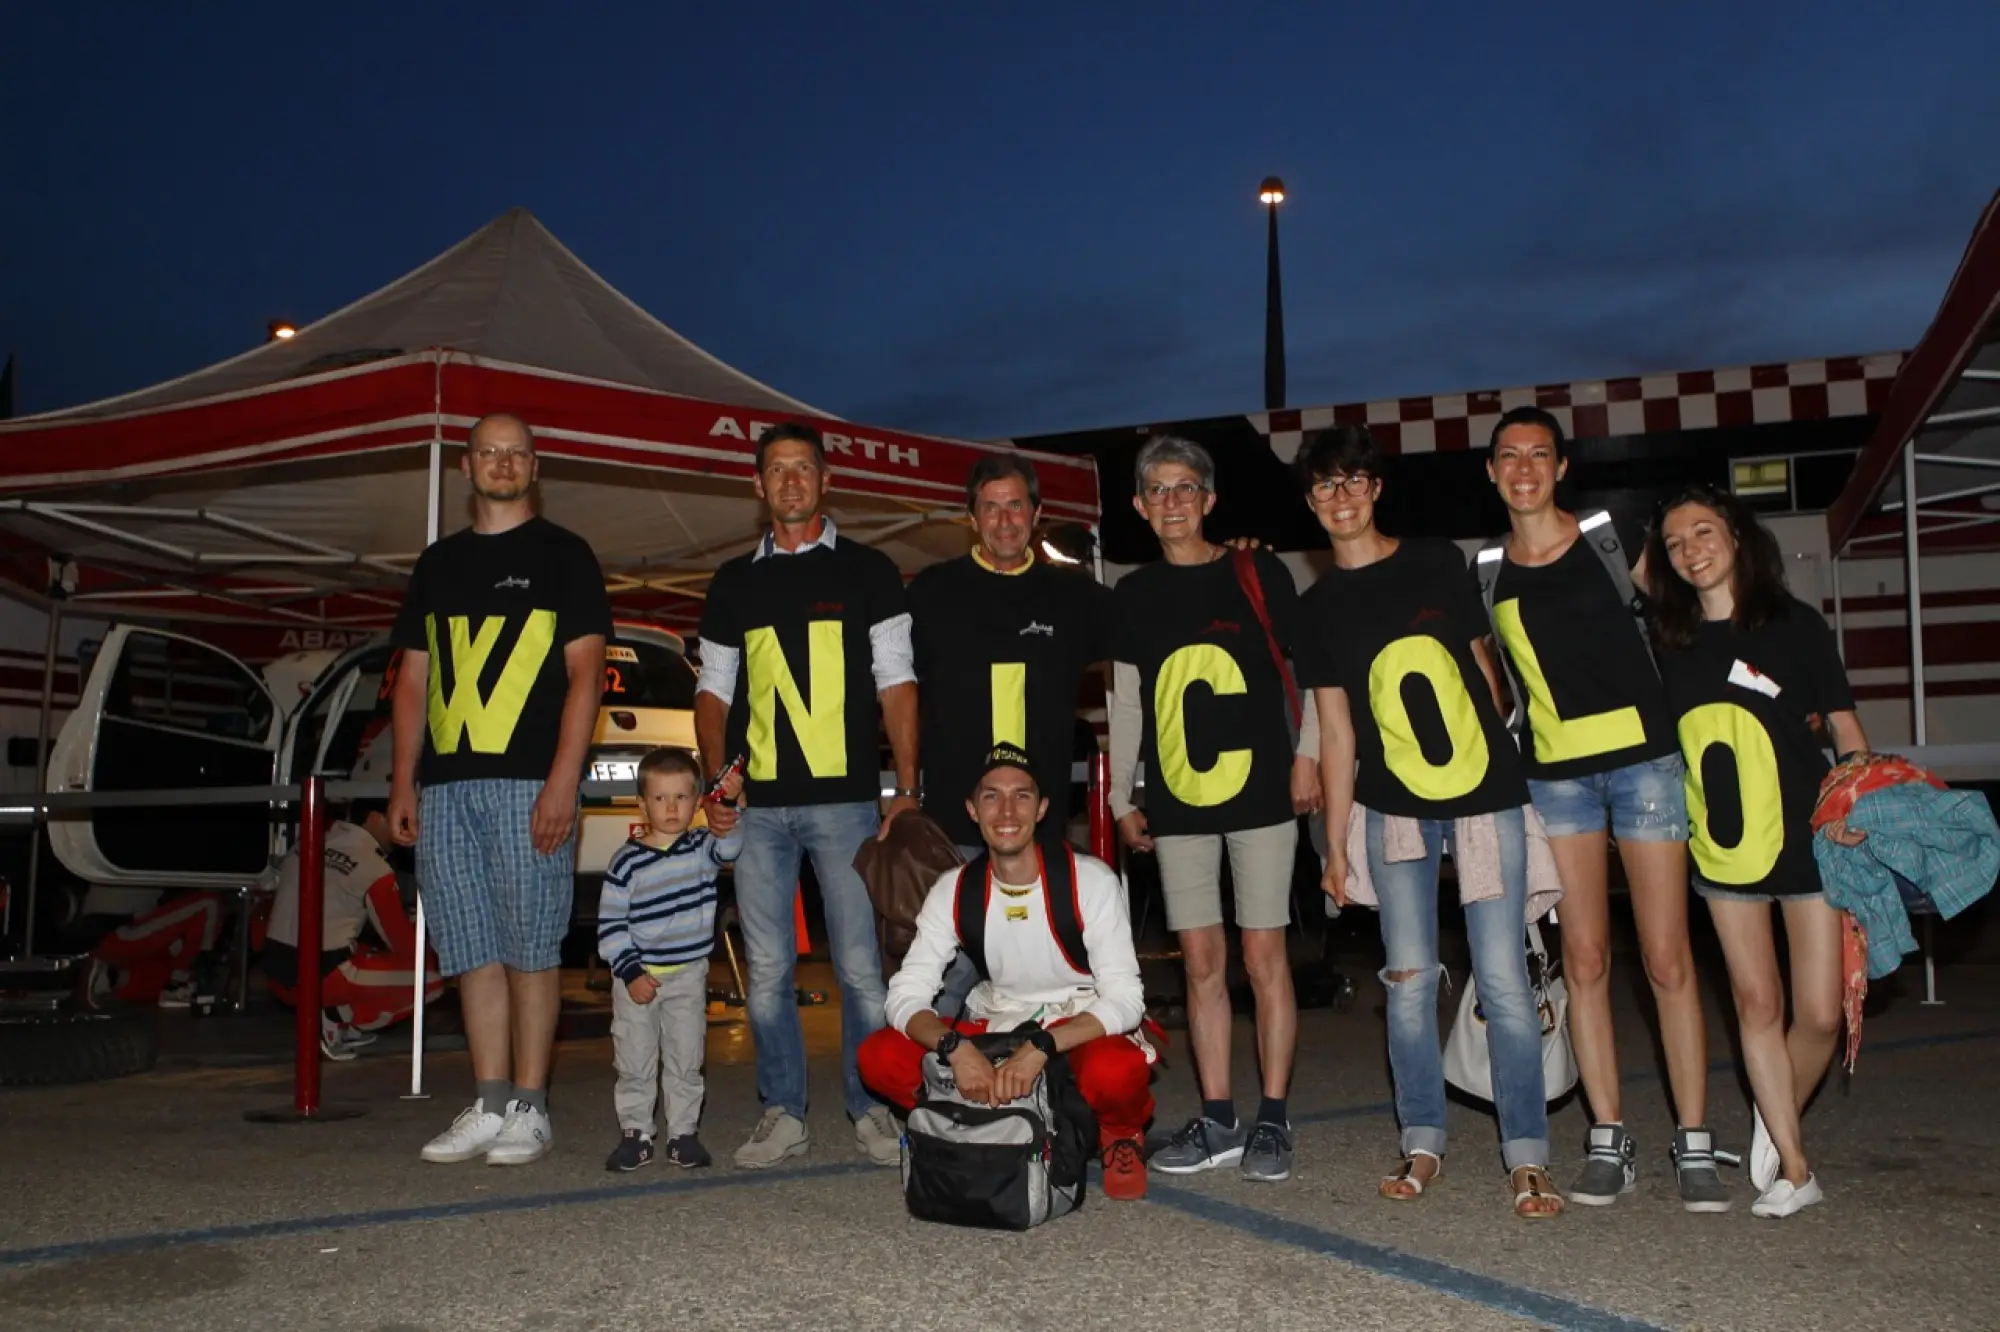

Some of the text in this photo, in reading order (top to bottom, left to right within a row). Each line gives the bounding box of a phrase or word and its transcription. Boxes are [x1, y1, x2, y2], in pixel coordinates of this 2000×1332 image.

[424, 609, 556, 753] W
[745, 620, 847, 780] N
[992, 663, 1025, 749] I
[1155, 644, 1252, 806] C
[1369, 635, 1489, 800] O
[1495, 599, 1645, 763] L
